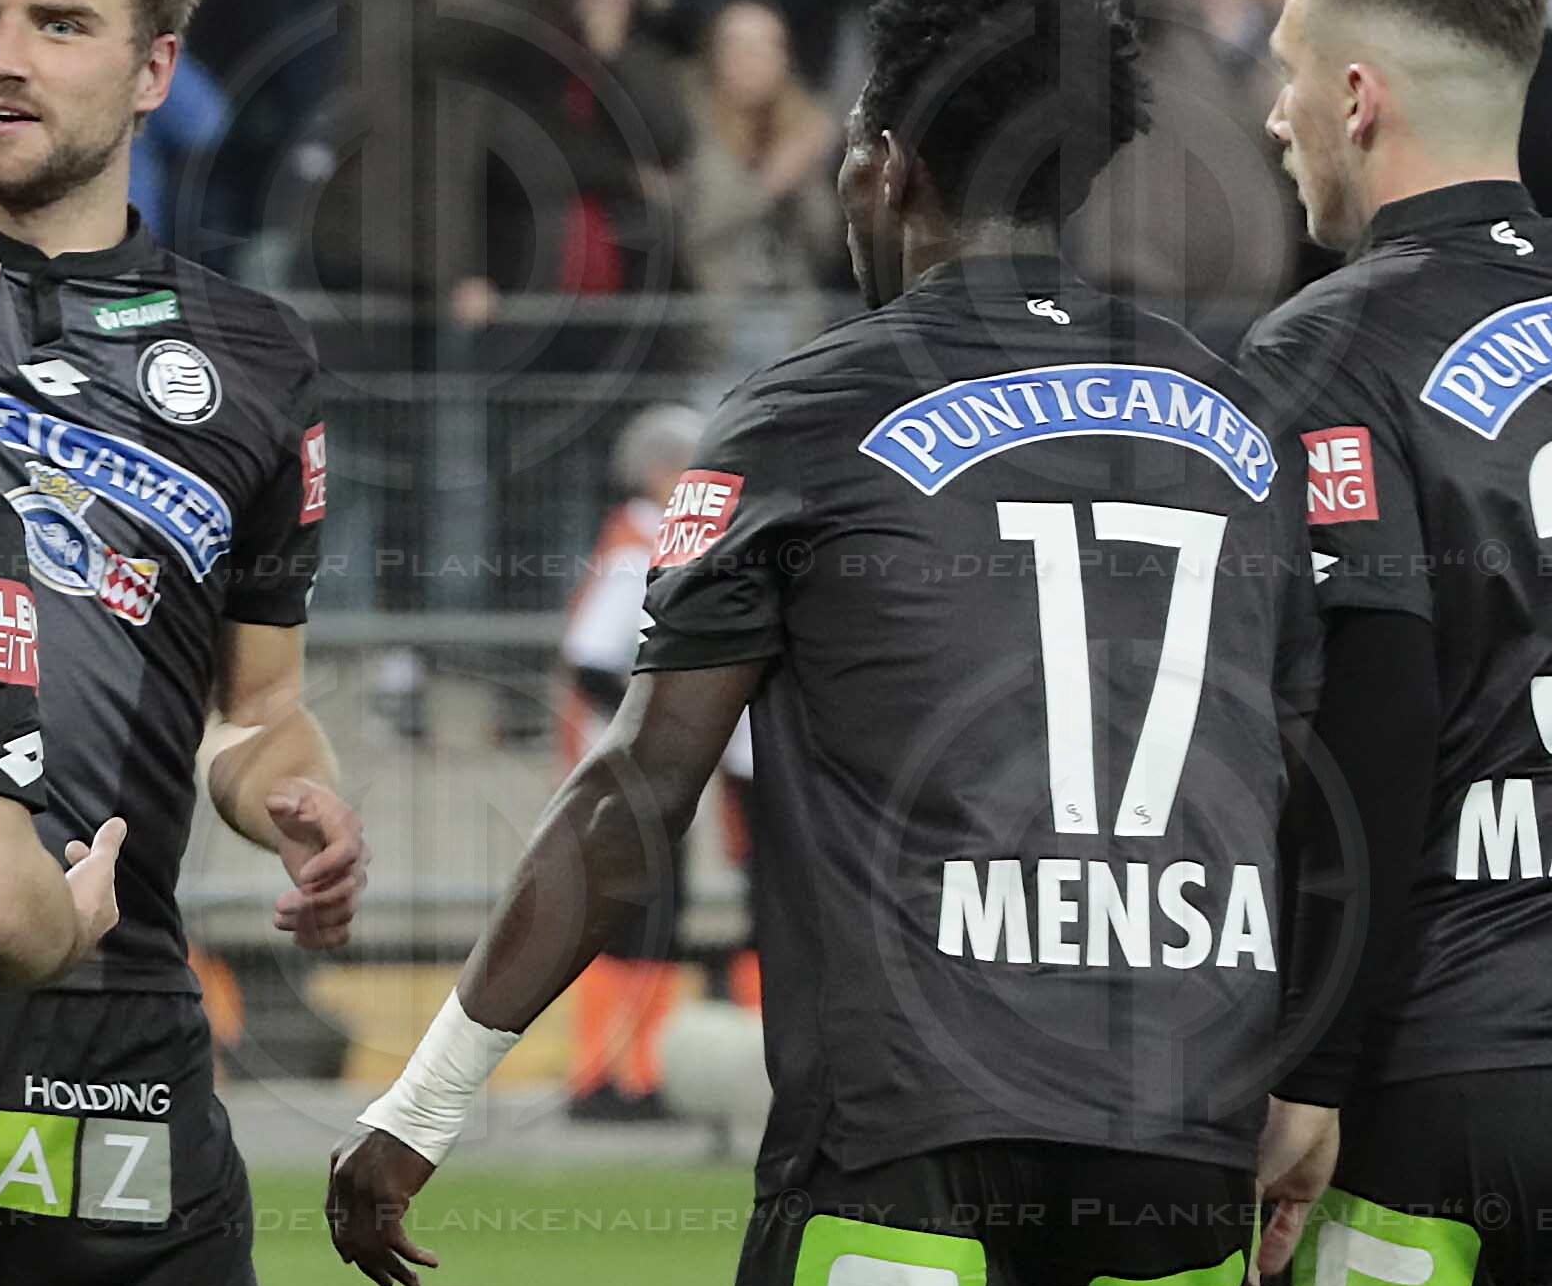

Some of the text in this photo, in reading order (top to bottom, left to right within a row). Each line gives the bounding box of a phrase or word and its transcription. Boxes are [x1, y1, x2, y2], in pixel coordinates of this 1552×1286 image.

[886, 376, 1270, 485] PUNTIGAMER
[996, 501, 1228, 837] 17
[937, 859, 1277, 972] MENSA
[24, 1075, 171, 1115] HOLDING
